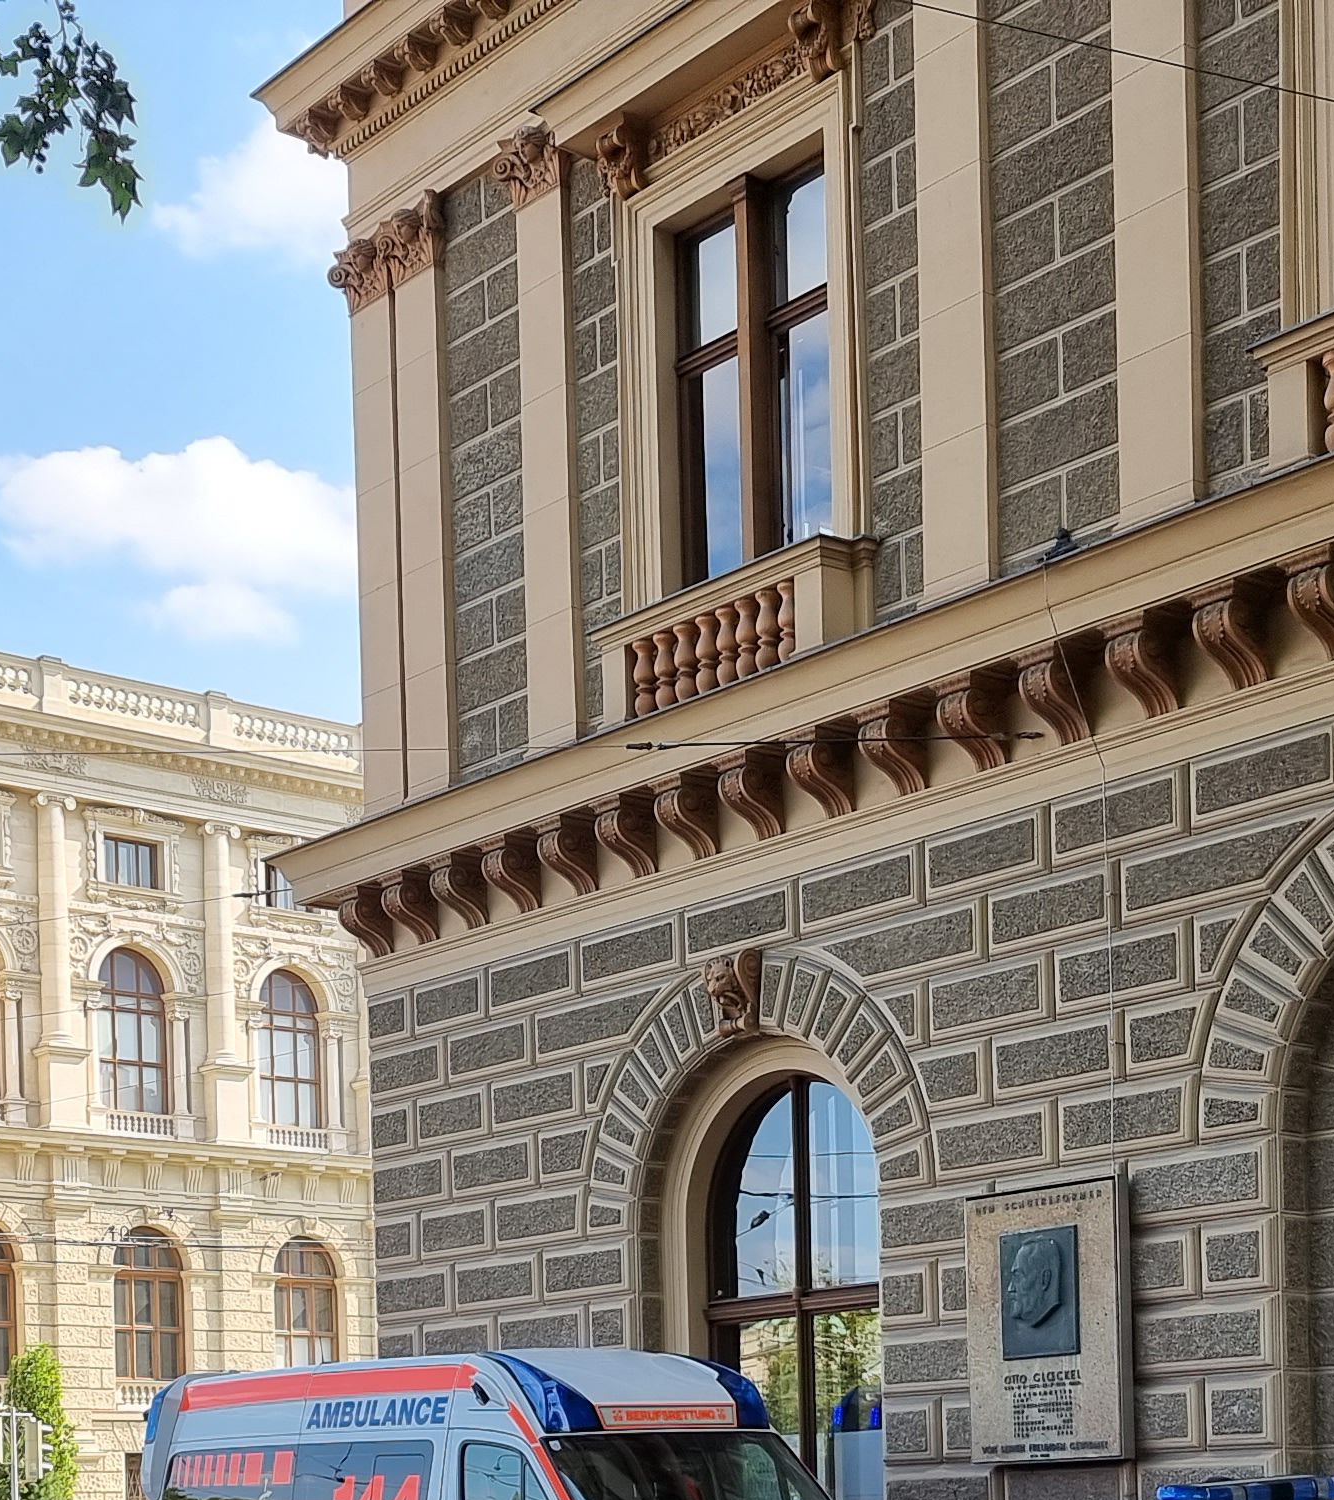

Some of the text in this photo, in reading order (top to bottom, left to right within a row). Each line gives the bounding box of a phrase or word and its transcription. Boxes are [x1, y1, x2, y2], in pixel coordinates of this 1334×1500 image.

[1003, 1374, 1028, 1385] OTTO
[305, 1396, 450, 1430] AMBULANCE
[625, 1408, 716, 1421] BERUFSRETTUNG
